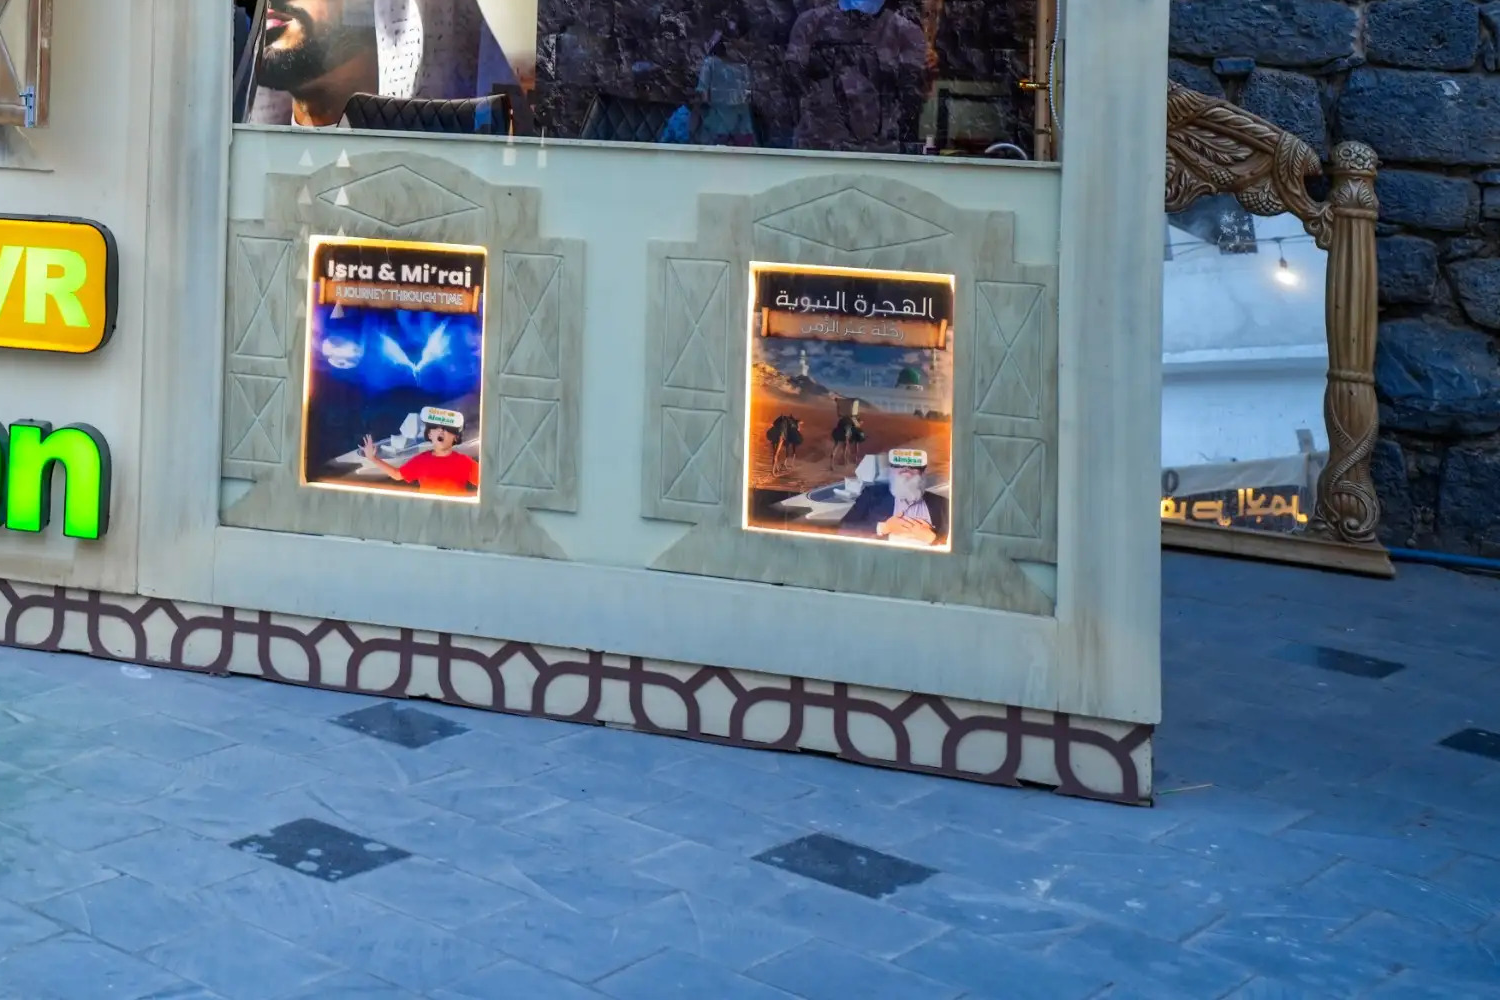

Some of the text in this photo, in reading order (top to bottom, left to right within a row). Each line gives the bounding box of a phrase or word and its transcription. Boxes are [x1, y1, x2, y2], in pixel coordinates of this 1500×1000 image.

[327, 259, 373, 280] Isra
[377, 263, 397, 281] &
[343, 286, 388, 301] JOURNEY
[388, 288, 437, 304] THROUGH
[438, 292, 464, 306] TIME
[775, 289, 935, 319] الهجرة النبوية
